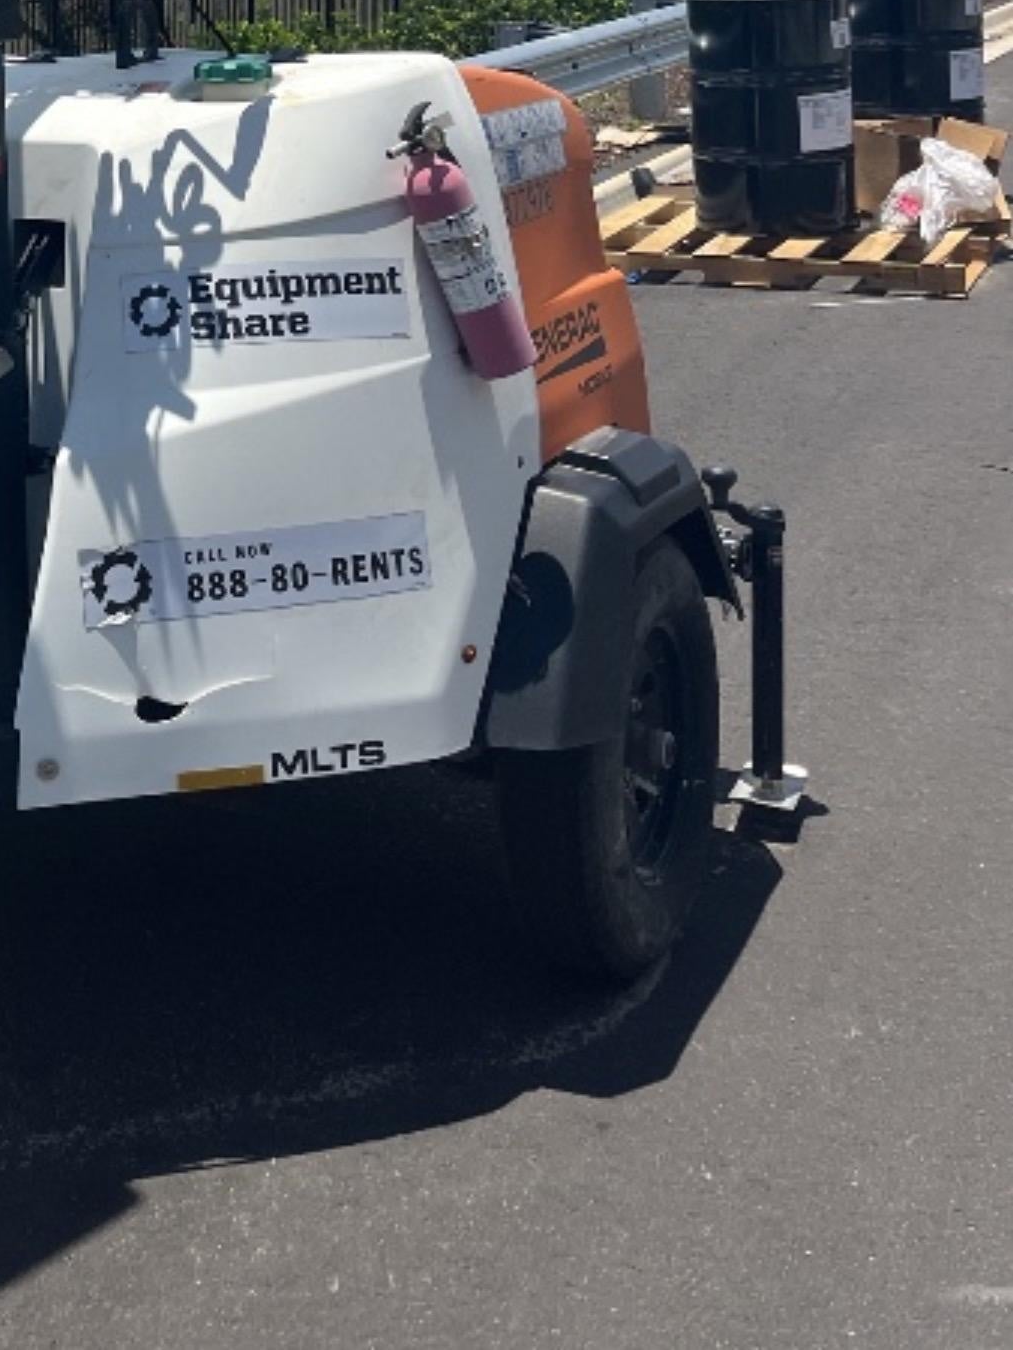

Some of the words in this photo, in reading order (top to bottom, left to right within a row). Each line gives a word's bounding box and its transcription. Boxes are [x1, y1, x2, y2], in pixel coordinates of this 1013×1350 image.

[188, 266, 402, 308] Equipment
[190, 308, 310, 339] Share
[531, 301, 600, 362] ENERAC
[185, 547, 228, 564] CALL
[235, 542, 272, 559] NOW
[188, 547, 424, 603] 888-80-RENTS
[271, 740, 387, 778] MLTS
